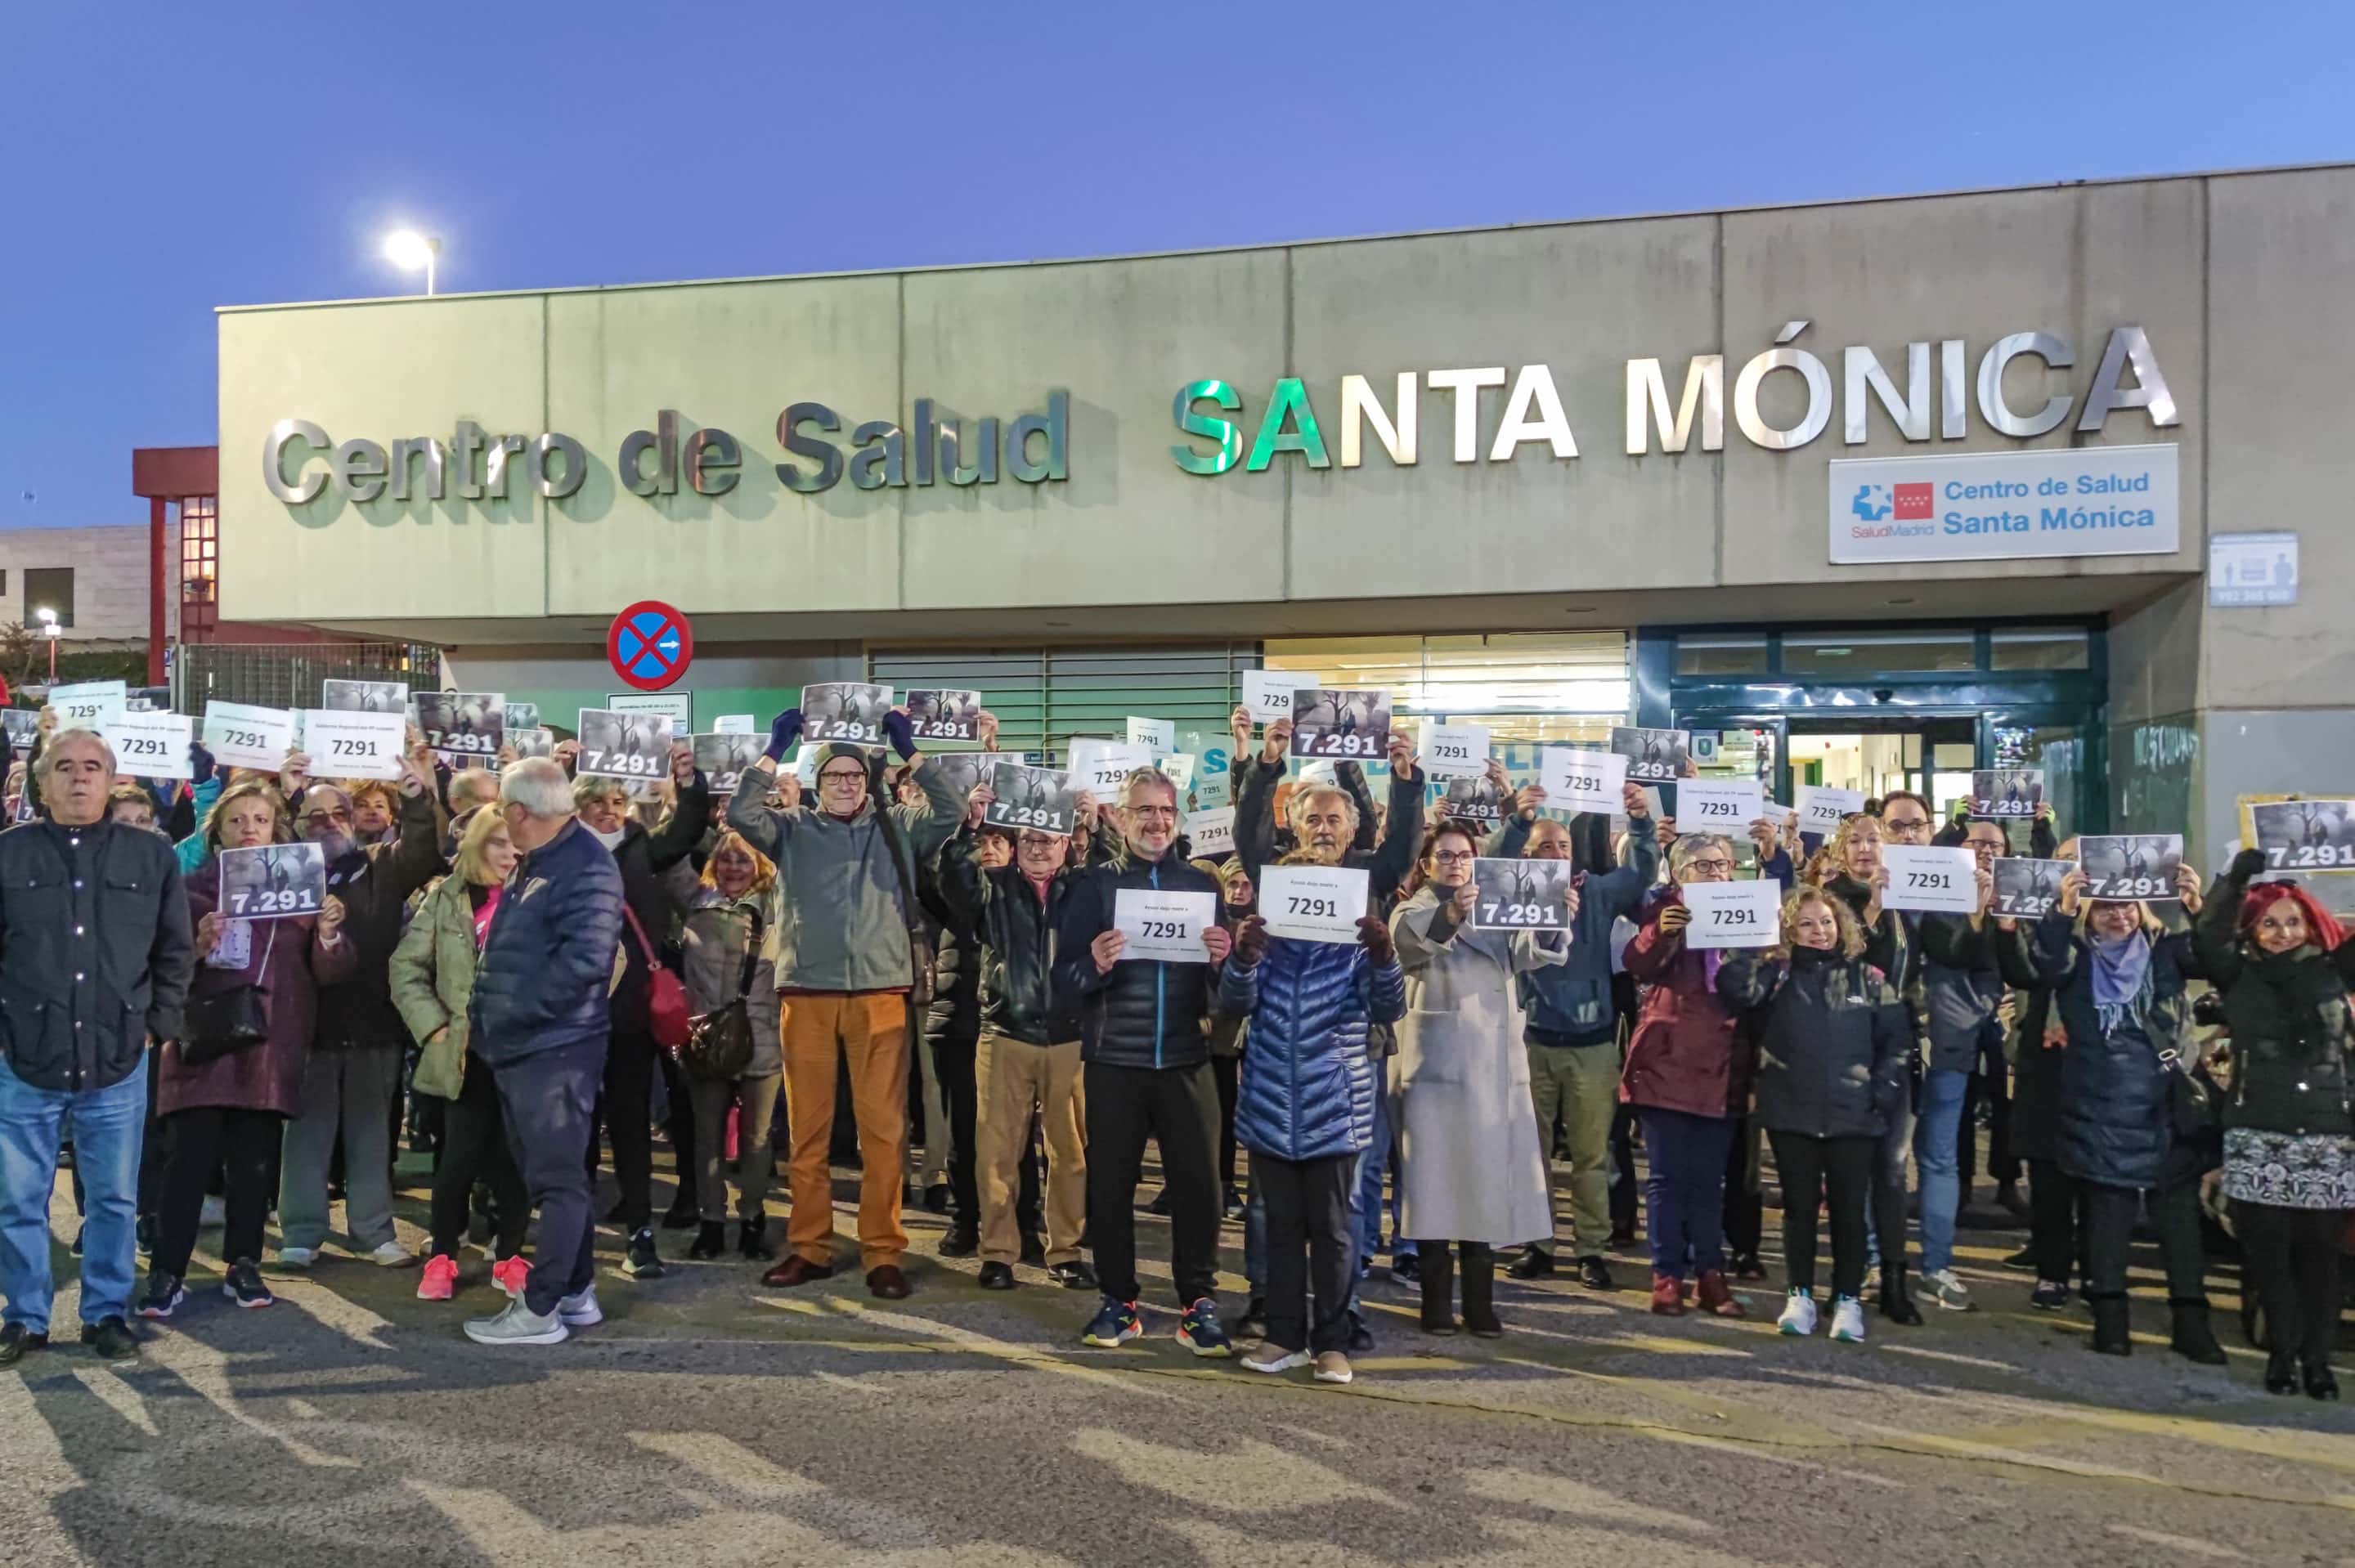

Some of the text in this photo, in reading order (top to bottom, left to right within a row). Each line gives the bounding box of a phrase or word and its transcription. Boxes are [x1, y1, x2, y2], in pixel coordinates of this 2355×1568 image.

[262, 320, 2180, 504] Centro de Salud SANTA MÓNICA
[1945, 473, 2149, 500] Centro de Salud
[1944, 505, 2154, 534] Santa Mónica
[1851, 523, 1935, 539] SaludMadrid
[1263, 694, 1289, 707] 729
[810, 720, 878, 741] 7.291
[912, 720, 970, 737] 7.291
[123, 738, 168, 755] 7291
[224, 729, 267, 748] 7291
[428, 729, 496, 751] 7.291
[1300, 732, 1378, 755] 7.291
[331, 740, 378, 756] 7291
[1434, 746, 1469, 759] 7291
[587, 750, 660, 775] 7.291
[1627, 762, 1676, 778] .291
[1564, 775, 1602, 791] 7291
[995, 803, 1062, 829] 7.291
[1451, 803, 1500, 818] 7.291
[1700, 803, 1739, 816] 7291
[1979, 800, 2035, 814] 7.291
[1200, 826, 1229, 840] 7291
[2268, 844, 2355, 867] 7.291
[1908, 873, 1951, 889] 7291
[2091, 877, 2169, 897] 7.291
[231, 889, 316, 914] 7.291
[1288, 897, 1337, 917] 7291
[2000, 894, 2054, 913] 7.29
[1483, 903, 1559, 925] 7.291
[1712, 909, 1757, 925] 7291
[1142, 921, 1187, 939] 7291
